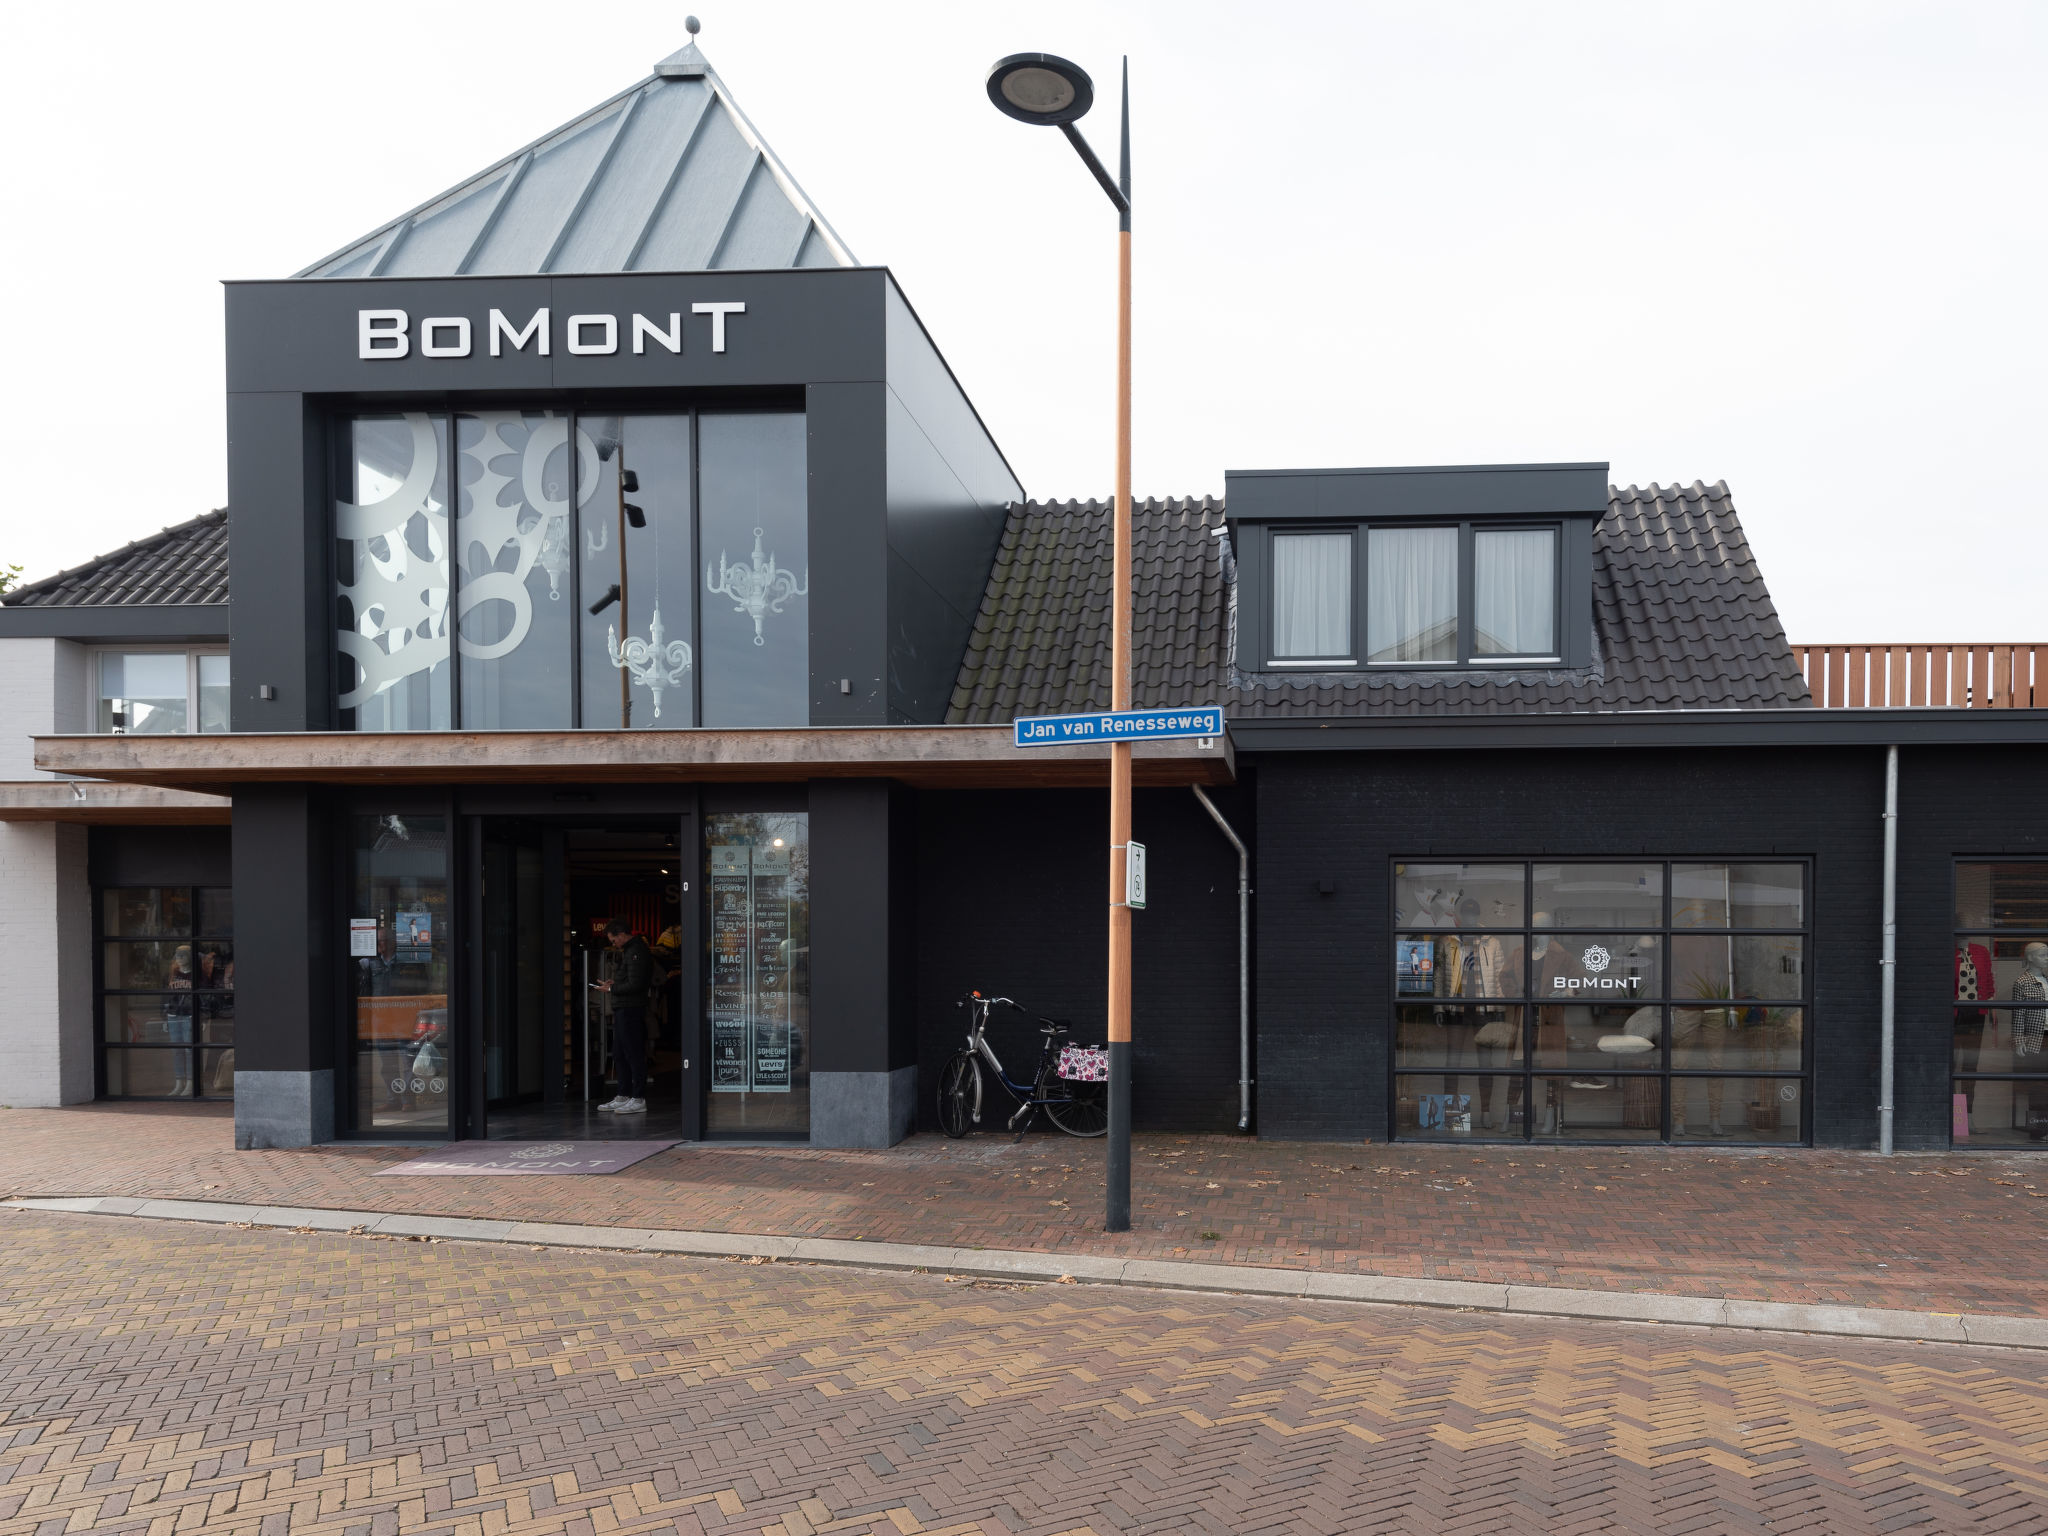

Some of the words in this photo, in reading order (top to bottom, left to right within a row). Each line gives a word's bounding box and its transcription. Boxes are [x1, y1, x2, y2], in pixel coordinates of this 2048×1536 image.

[1023, 722, 1056, 738] Jan
[1062, 721, 1094, 736] van
[1100, 714, 1215, 733] Renesseweg
[720, 955, 741, 964] MAC
[757, 1047, 787, 1055] SOMEONE
